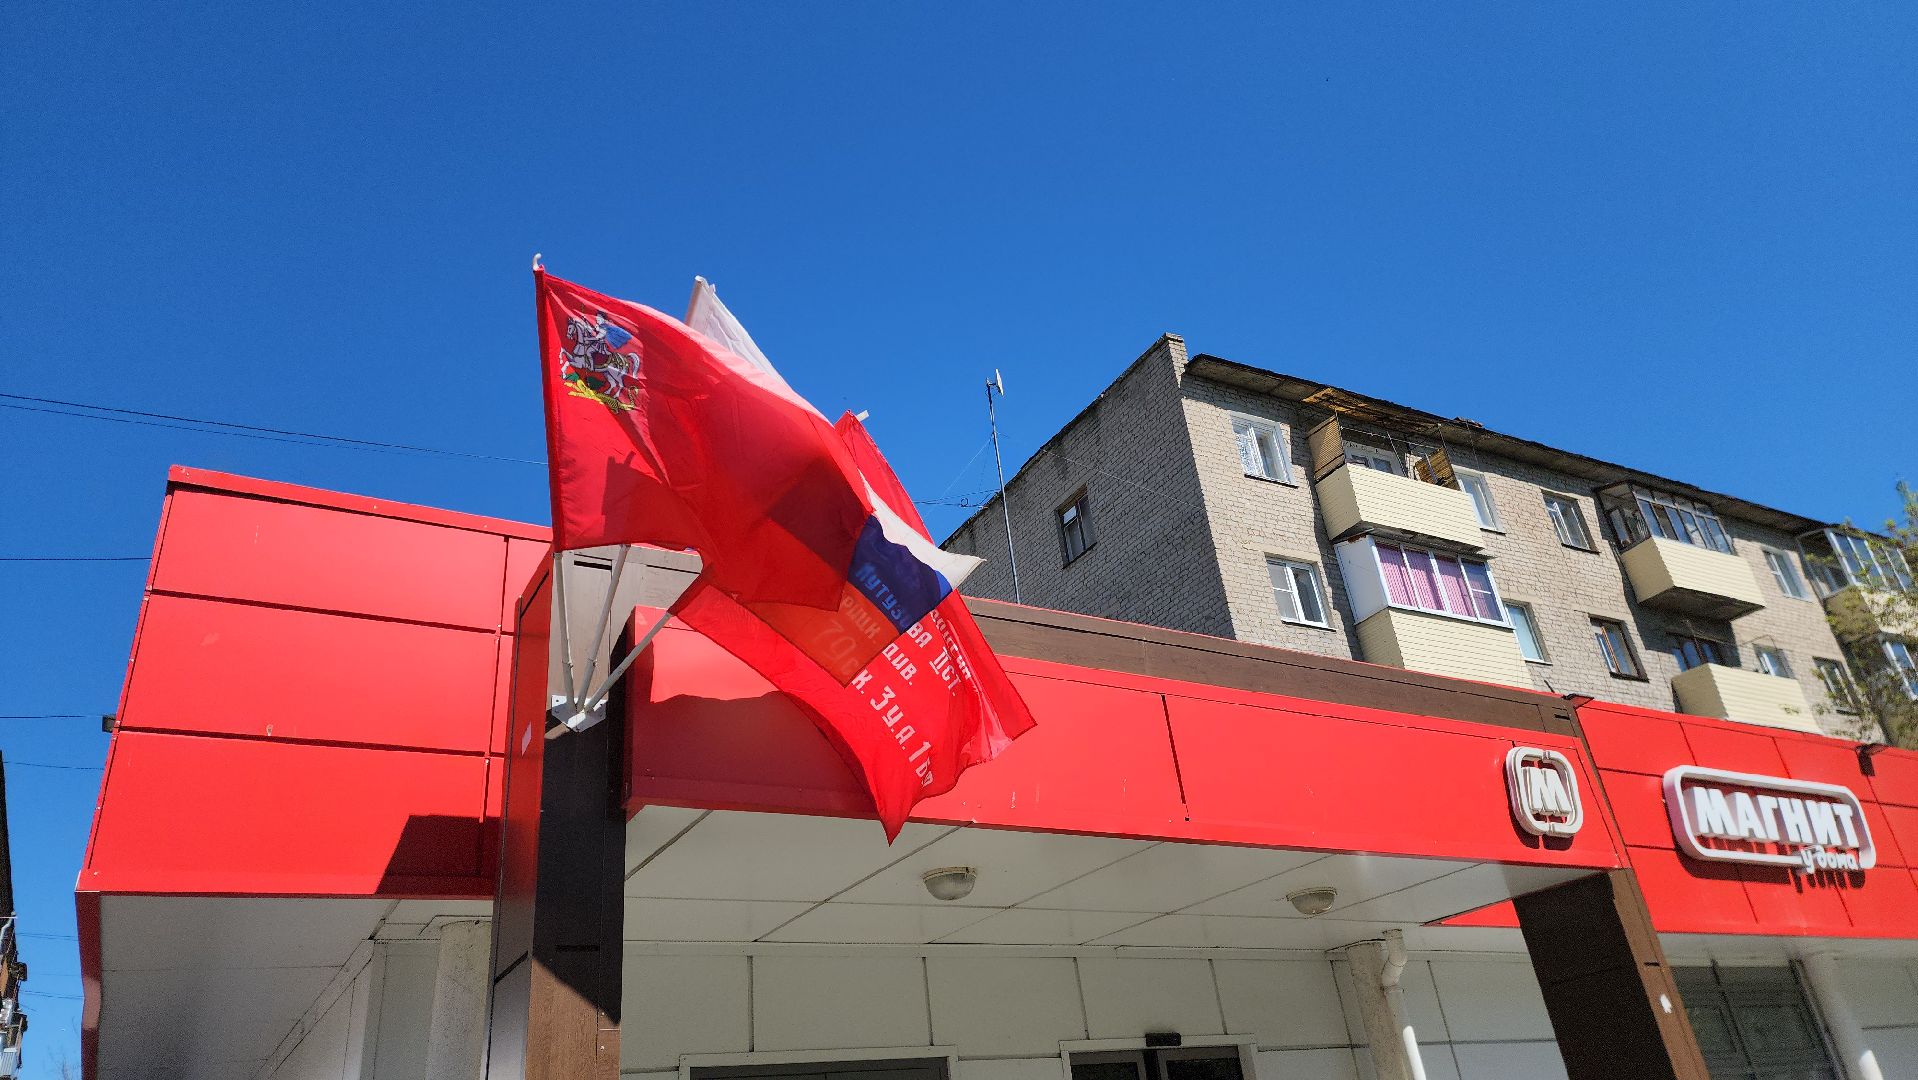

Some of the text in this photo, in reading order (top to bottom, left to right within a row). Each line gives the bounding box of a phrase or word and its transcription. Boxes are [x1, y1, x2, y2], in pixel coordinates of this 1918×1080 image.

[882, 642, 917, 686] ДИВ.
[870, 685, 896, 711] 3
[909, 741, 931, 763] 1
[1524, 767, 1573, 815] М
[1690, 786, 1859, 847] МАГНИТ
[1801, 844, 1859, 874] у дома
